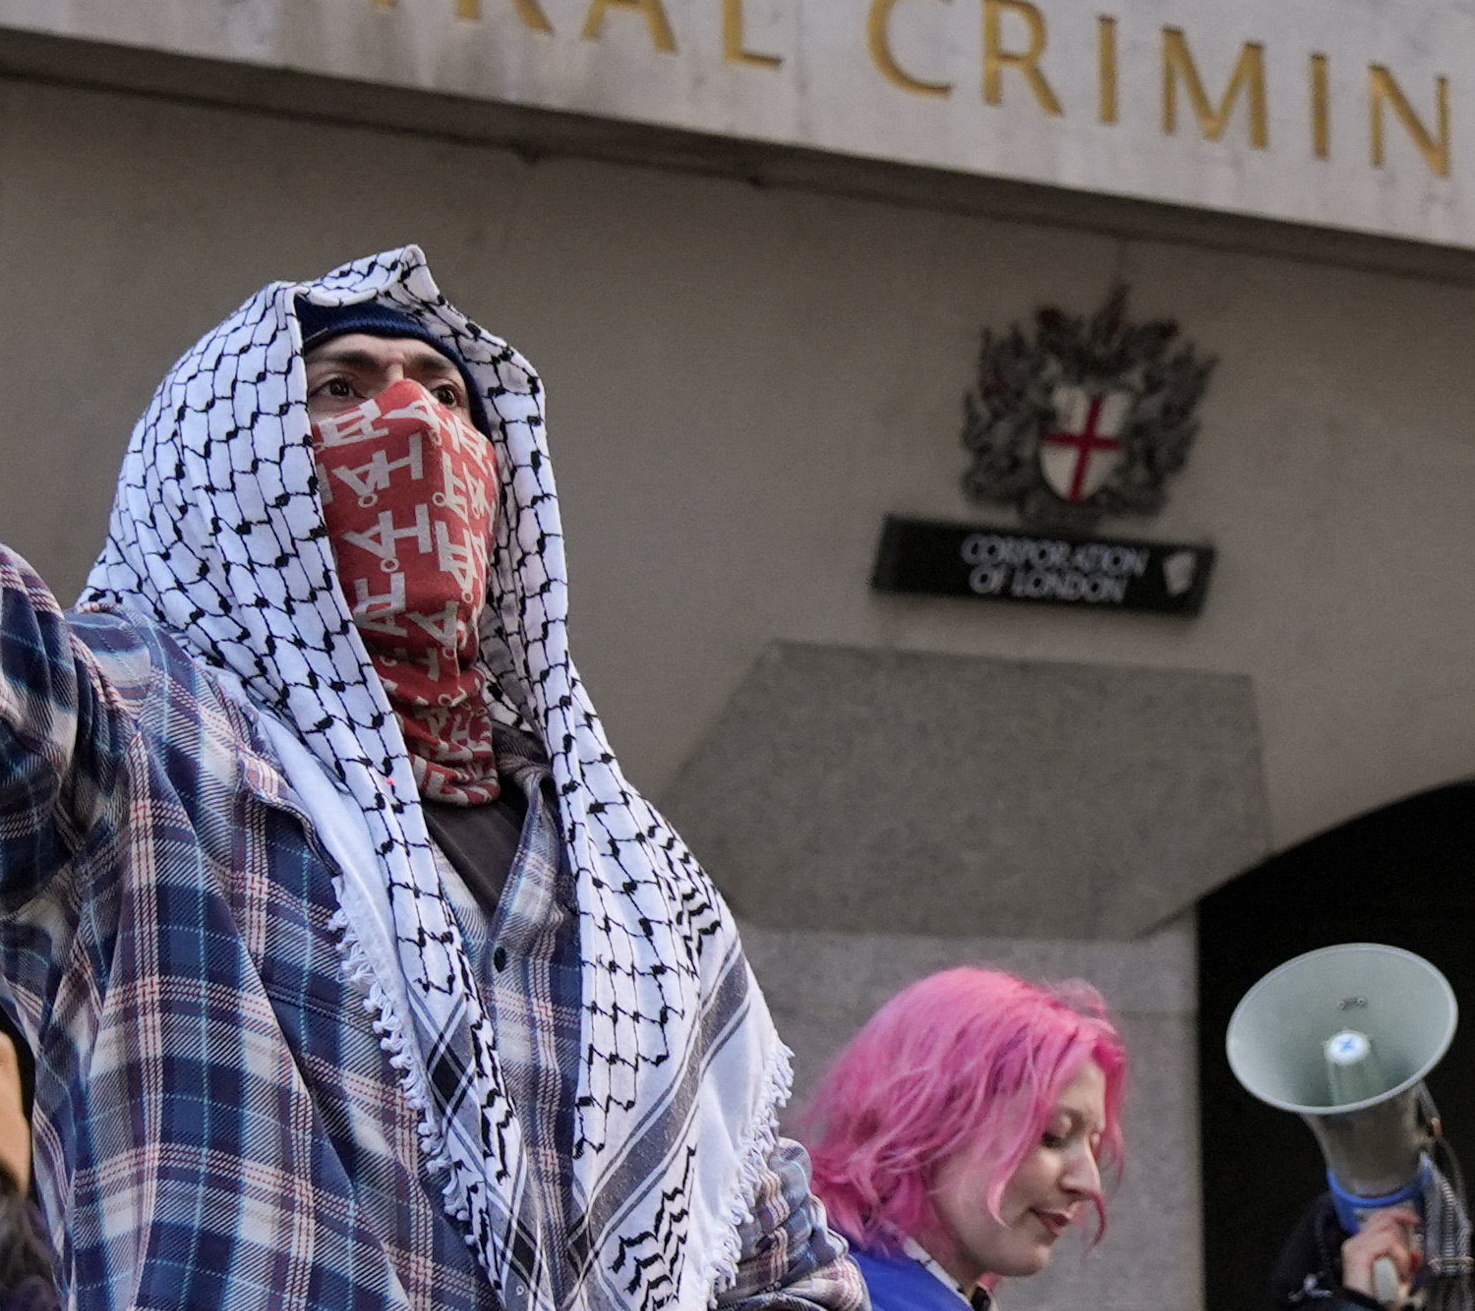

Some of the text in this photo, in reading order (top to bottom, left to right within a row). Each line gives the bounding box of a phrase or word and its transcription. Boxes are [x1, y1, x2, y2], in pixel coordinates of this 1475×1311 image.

[961, 534, 1150, 577] CORPORATION
[970, 564, 1125, 603] OF LONDON
